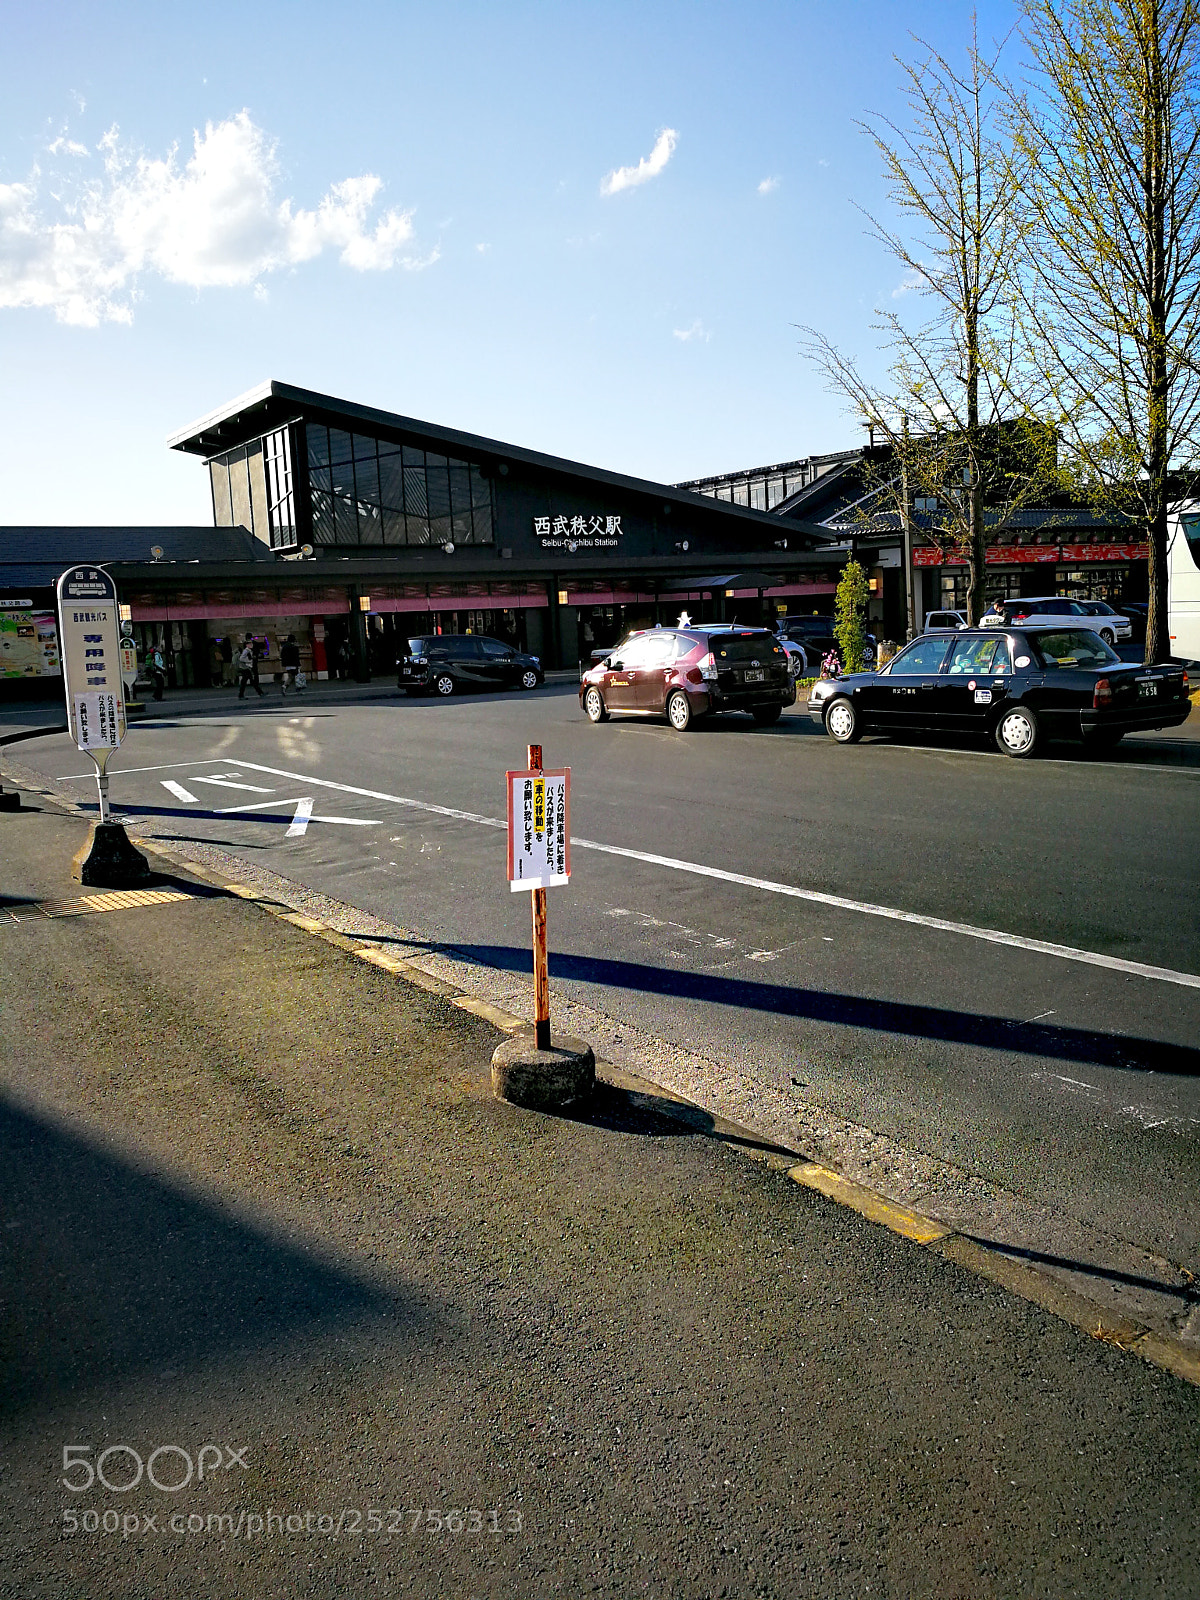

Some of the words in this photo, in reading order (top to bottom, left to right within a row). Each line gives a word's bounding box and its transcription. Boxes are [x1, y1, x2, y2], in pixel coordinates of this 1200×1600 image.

[533, 514, 623, 536] 西武秩父駅
[594, 538, 618, 546] Station
[75, 571, 98, 580] 西武
[73, 612, 108, 623] 西武観光バス
[159, 772, 384, 837] バス
[524, 779, 533, 855] お願い致します。
[546, 787, 554, 870] バスが来ましたら、
[556, 784, 564, 874] バスの降車場に着き
